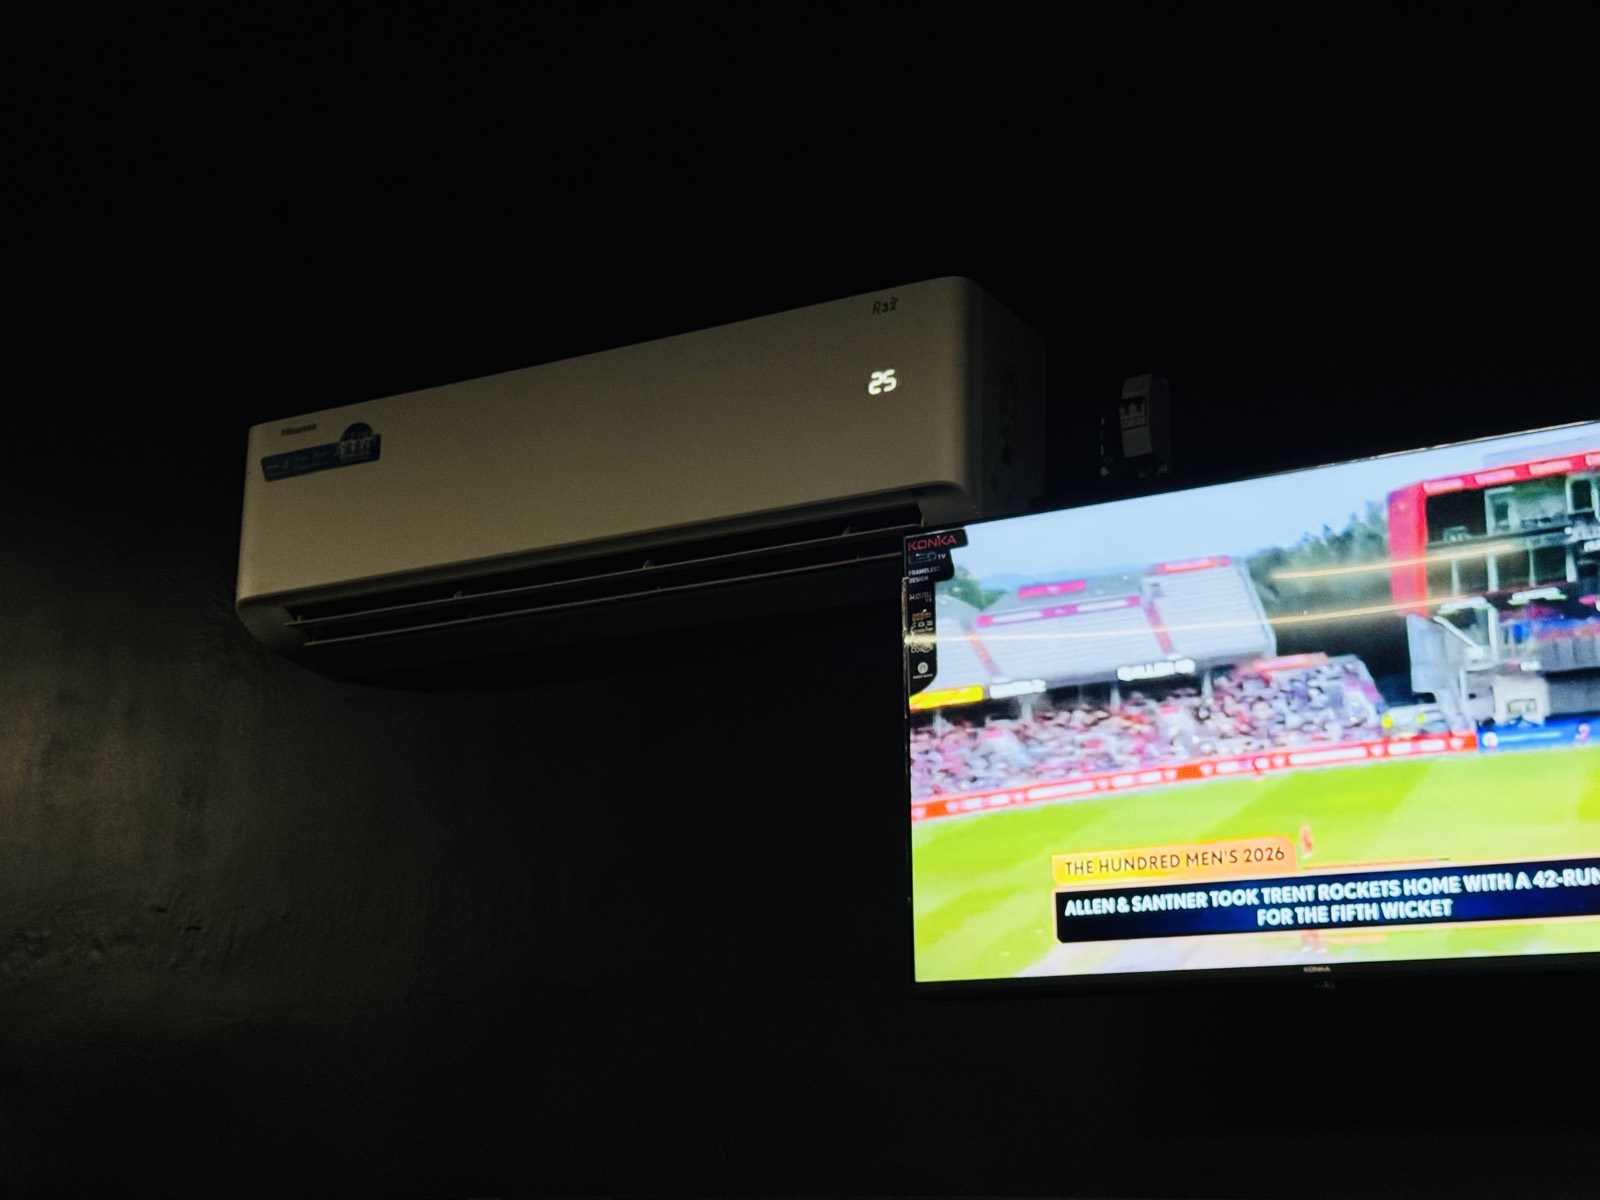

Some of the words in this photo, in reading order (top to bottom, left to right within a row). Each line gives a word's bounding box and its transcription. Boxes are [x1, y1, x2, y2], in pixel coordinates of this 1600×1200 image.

[868, 368, 897, 395] 25
[907, 535, 957, 551] KONKA
[1065, 861, 1094, 876] THE
[1100, 854, 1180, 872] HUNDRED
[1186, 850, 1238, 867] MEN'S
[1243, 847, 1285, 863] 2026
[1064, 897, 1116, 917] ALLEN
[1116, 896, 1130, 912] &
[1131, 891, 1209, 912] SANTNER
[1209, 888, 1260, 907] TOOK
[1261, 884, 1315, 904] TRENT
[1317, 879, 1402, 901] ROCKETS
[1403, 875, 1462, 896] HOME
[1462, 872, 1514, 893] WITH
[1515, 871, 1533, 890] A
[1257, 908, 1293, 927] FOR
[1295, 905, 1329, 924] THE
[1331, 902, 1380, 922] FIFTH
[1381, 898, 1454, 920] WICKET
